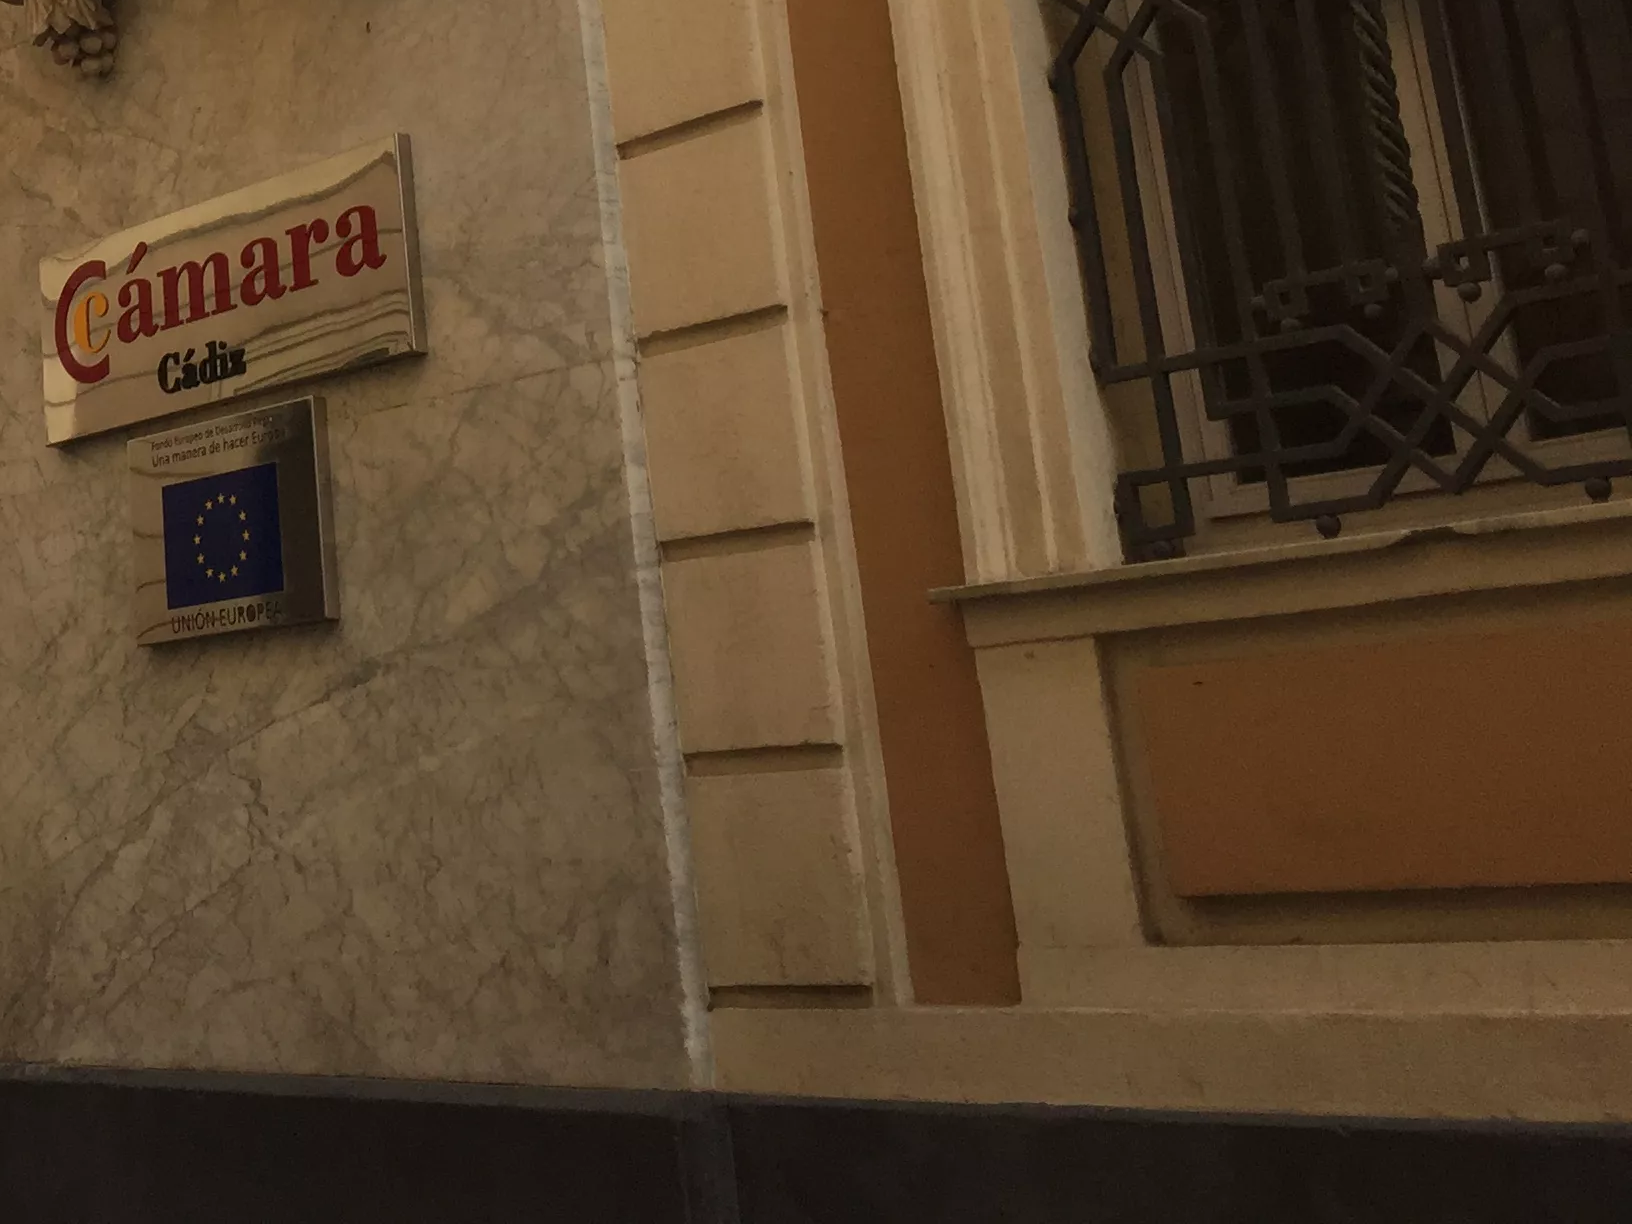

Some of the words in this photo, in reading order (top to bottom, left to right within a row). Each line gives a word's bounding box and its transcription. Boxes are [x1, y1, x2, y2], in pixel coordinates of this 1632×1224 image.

[55, 204, 388, 384] Cámara
[158, 340, 247, 394] Cádiz
[152, 453, 170, 468] Una
[172, 447, 207, 462] manera
[208, 441, 221, 454] de
[223, 436, 249, 451] hacer
[172, 608, 215, 633] UNIÓN
